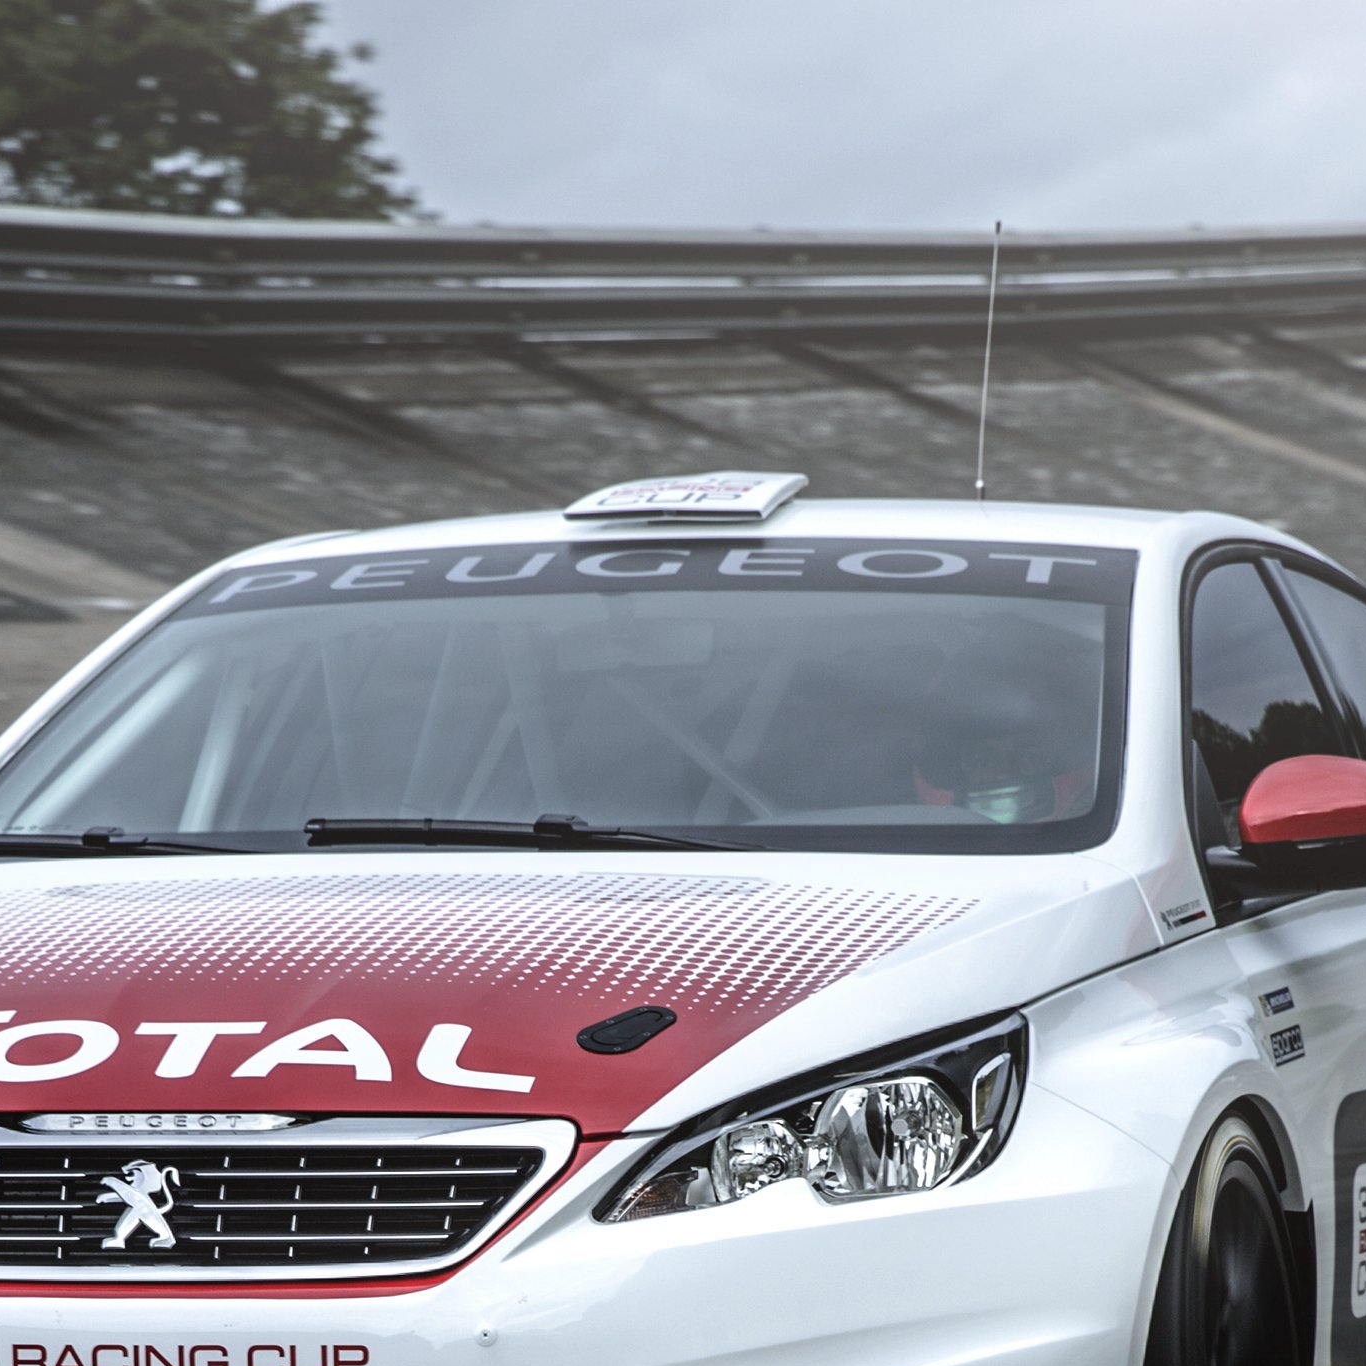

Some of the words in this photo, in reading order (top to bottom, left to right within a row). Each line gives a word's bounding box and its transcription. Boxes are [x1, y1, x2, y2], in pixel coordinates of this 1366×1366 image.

[597, 492, 742, 506] CUP
[209, 549, 1098, 604] PEUGEOT
[69, 1115, 242, 1129] PEUGEOT
